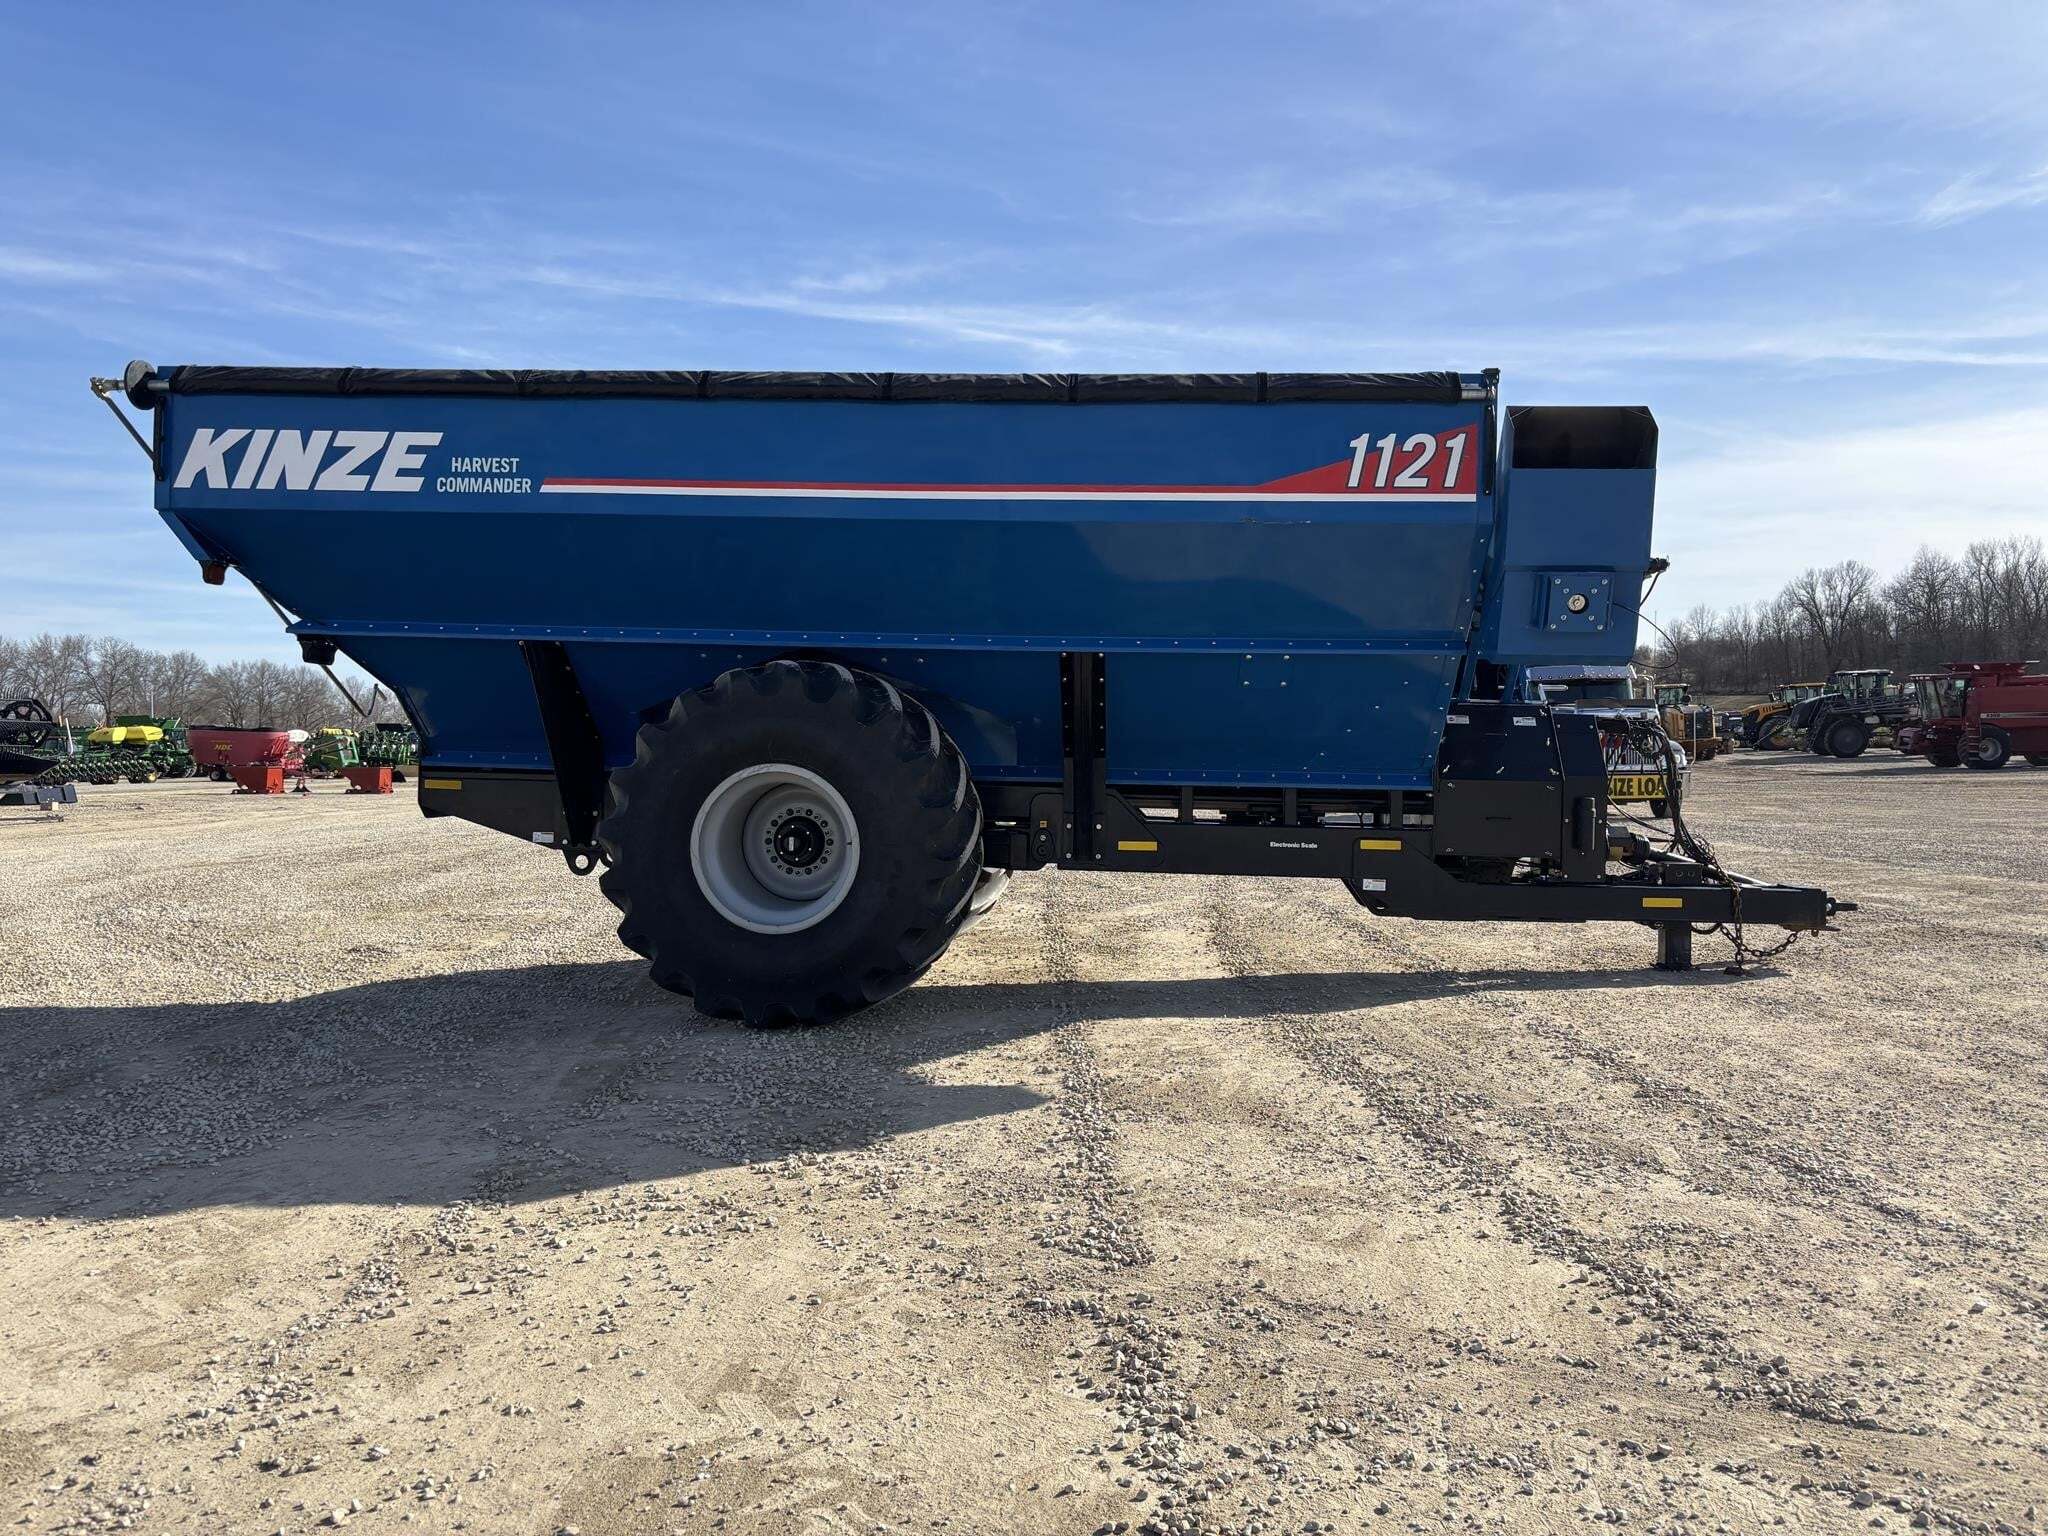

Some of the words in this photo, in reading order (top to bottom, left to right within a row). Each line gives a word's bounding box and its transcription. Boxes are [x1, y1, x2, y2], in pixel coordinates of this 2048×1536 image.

[173, 428, 444, 492] KINZE
[451, 457, 520, 473] HARVEST
[1347, 432, 1467, 488] 1121
[436, 477, 532, 494] COMMANDER
